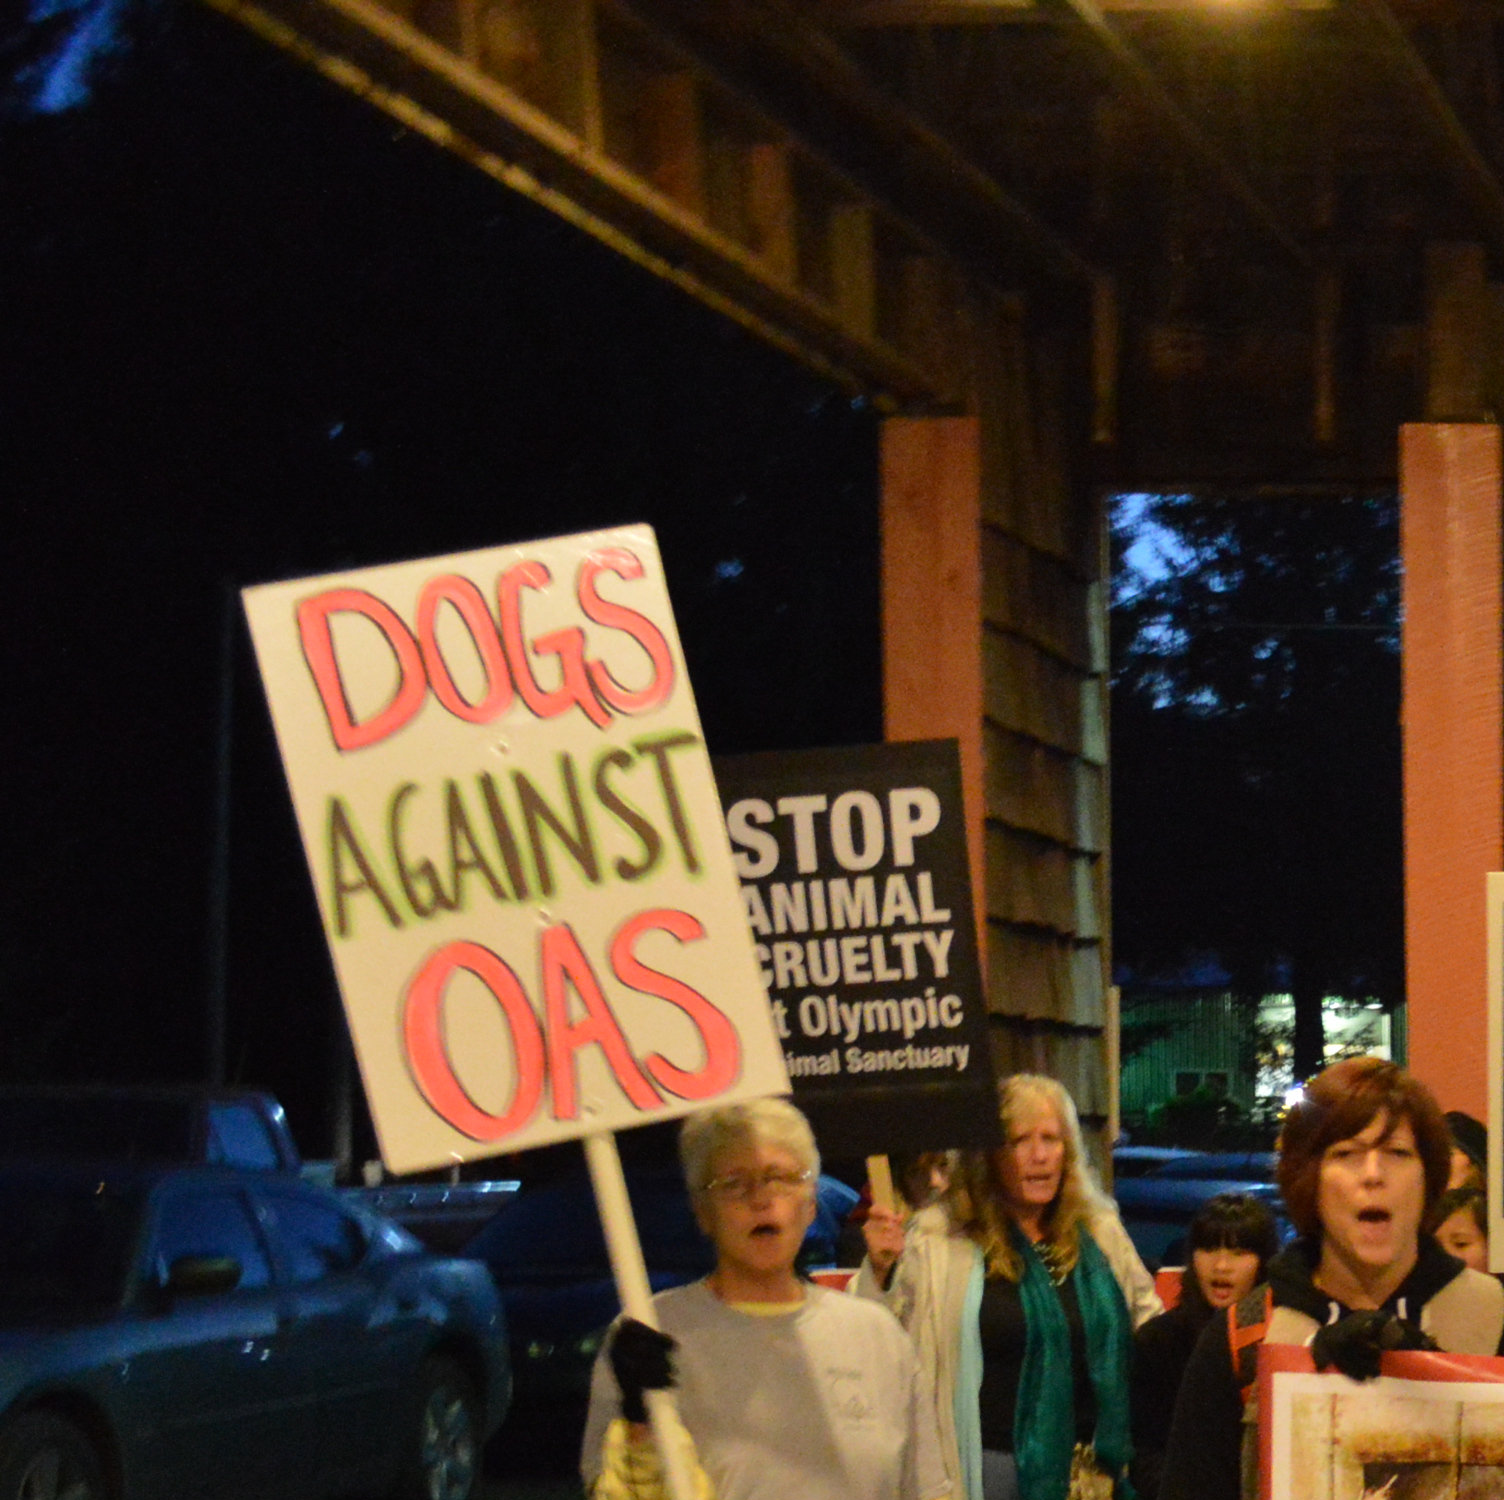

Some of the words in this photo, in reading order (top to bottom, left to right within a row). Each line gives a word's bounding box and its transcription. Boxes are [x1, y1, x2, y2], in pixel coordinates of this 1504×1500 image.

[296, 547, 675, 752] DOGS
[328, 732, 701, 938] AGAINST
[727, 787, 941, 880] STOP
[404, 909, 742, 1143] OAS
[770, 1000, 790, 1039] t
[800, 987, 963, 1043] Olympic
[786, 1049, 839, 1076] imal
[847, 1043, 969, 1074] Sanctuary
